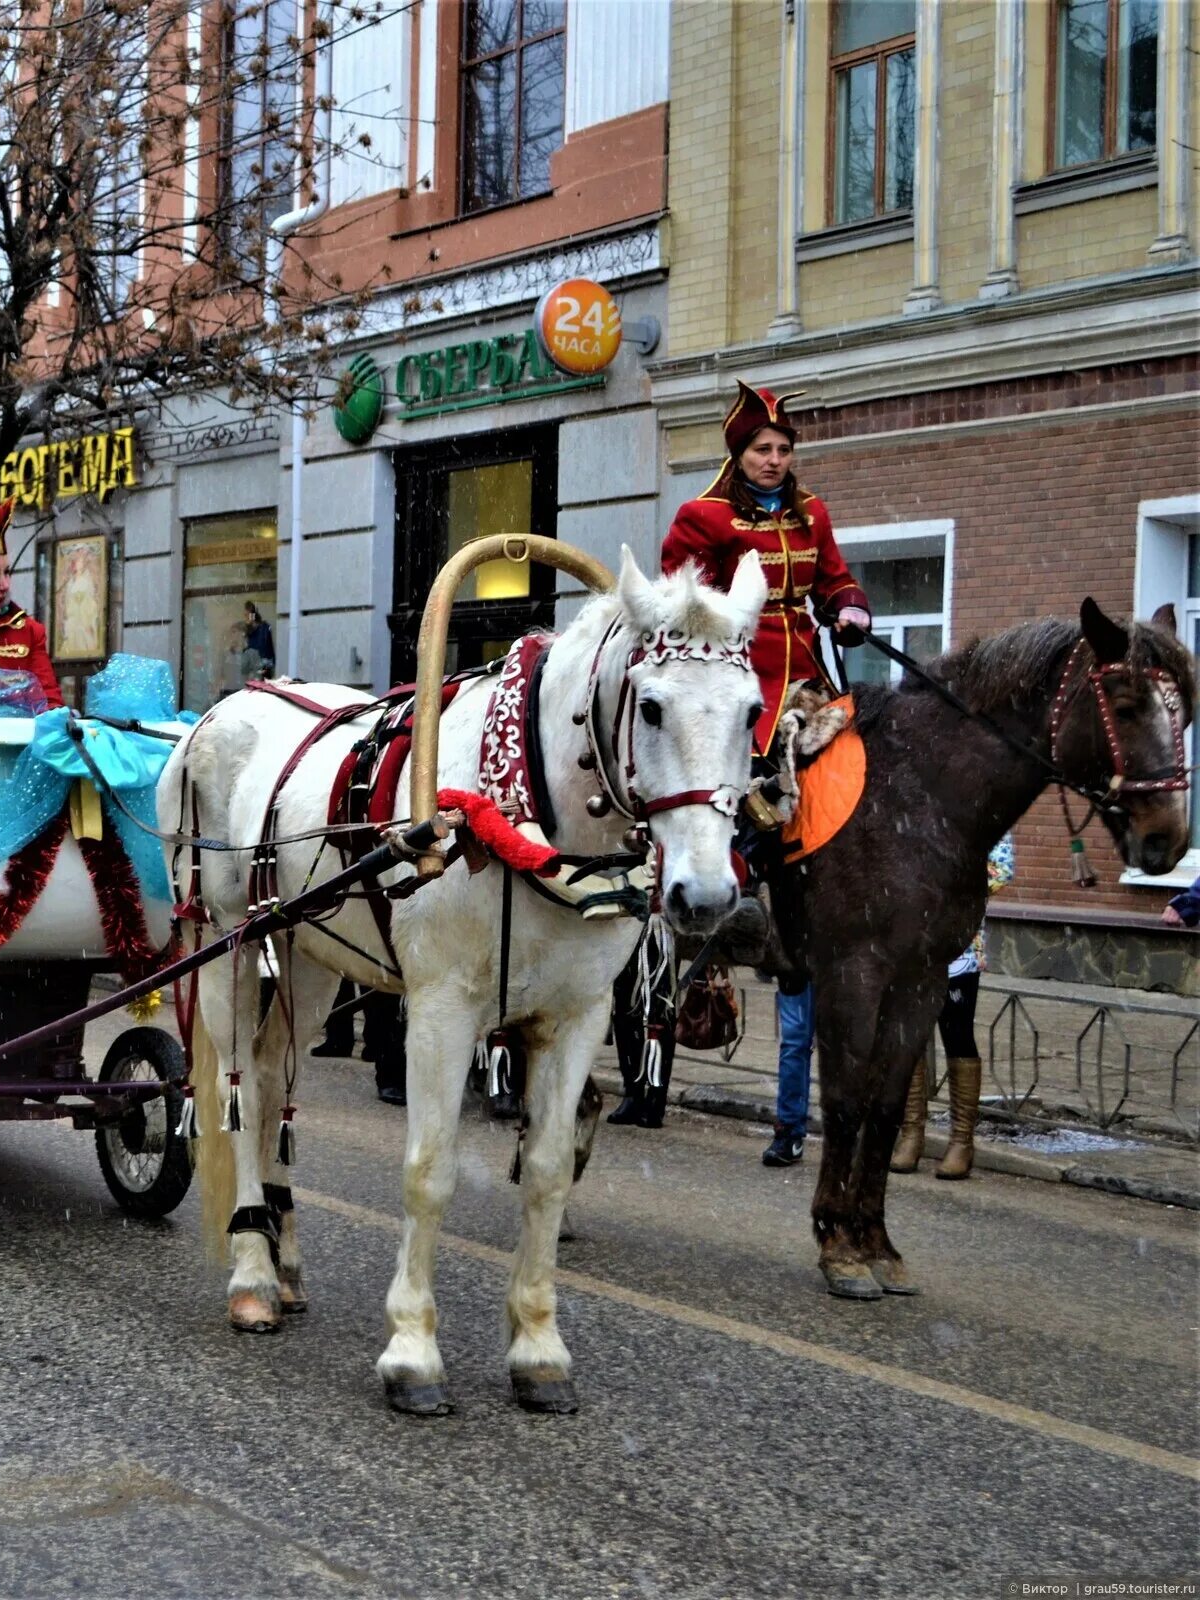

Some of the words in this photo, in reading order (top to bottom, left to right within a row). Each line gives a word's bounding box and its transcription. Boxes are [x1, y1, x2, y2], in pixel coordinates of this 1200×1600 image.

[555, 296, 604, 336] 24
[553, 335, 601, 356] ЧАСА
[0, 426, 137, 511] БОГЕМА
